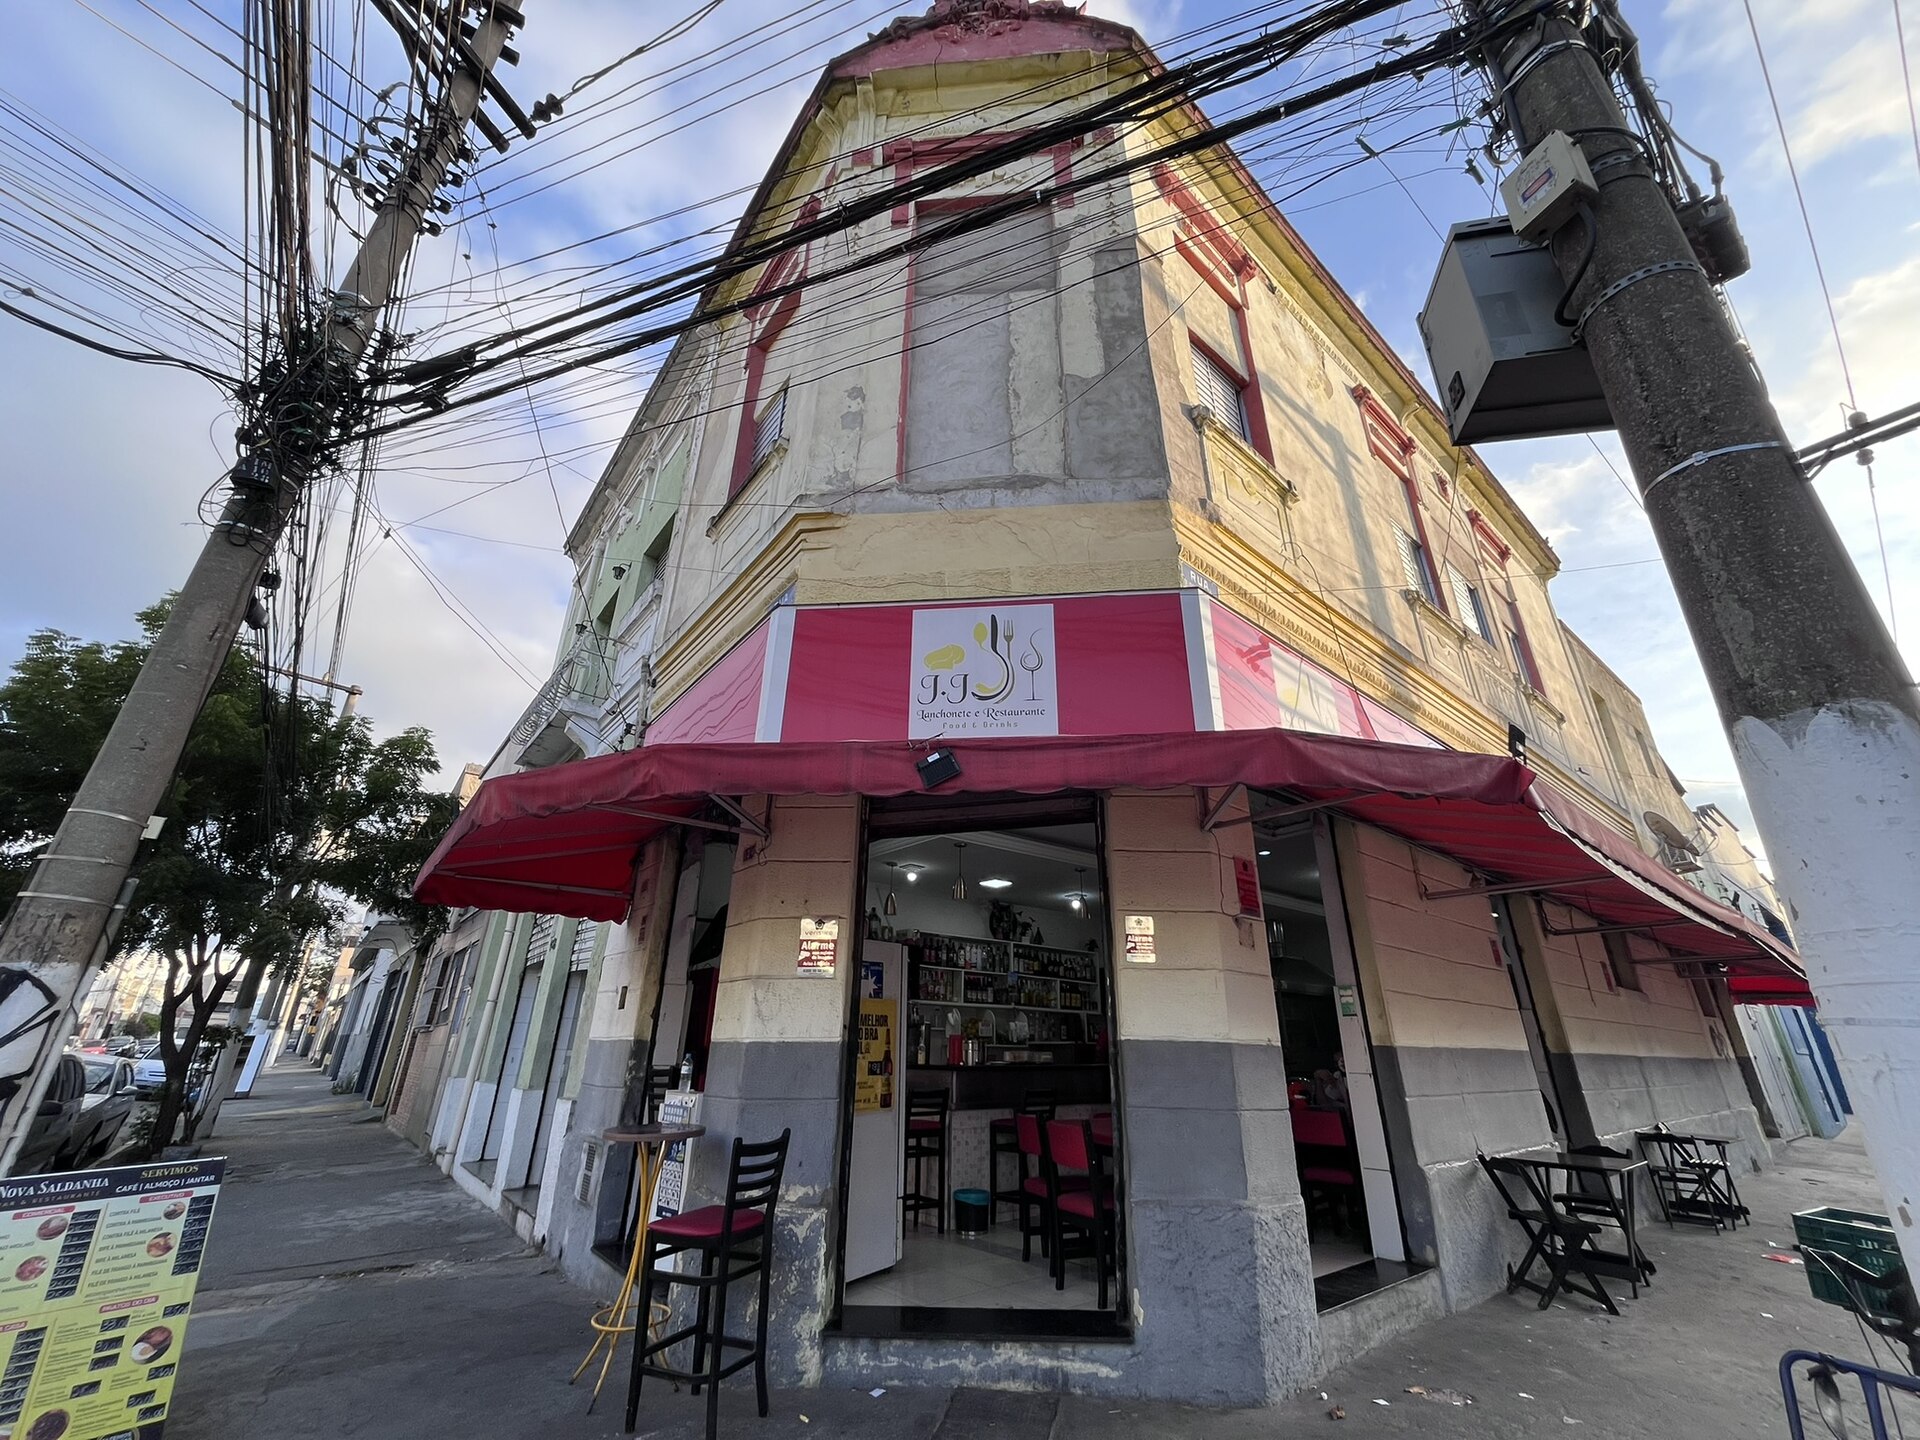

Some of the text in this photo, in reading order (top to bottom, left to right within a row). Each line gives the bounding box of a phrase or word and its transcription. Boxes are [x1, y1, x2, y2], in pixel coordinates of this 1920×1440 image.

[917, 709, 972, 722] Lanchonete
[983, 707, 1046, 720] Restaurante
[983, 721, 1019, 729] Drinks
[801, 941, 835, 950] Alarme
[859, 1013, 889, 1027] MELHOR
[140, 1165, 199, 1179] SERVIMOS
[0, 1177, 109, 1199] NOVA SALDANHA
[115, 1175, 216, 1193] CAFÉ ALMOÇO JANTAR
[32, 1190, 101, 1204] RESTAURANTE
